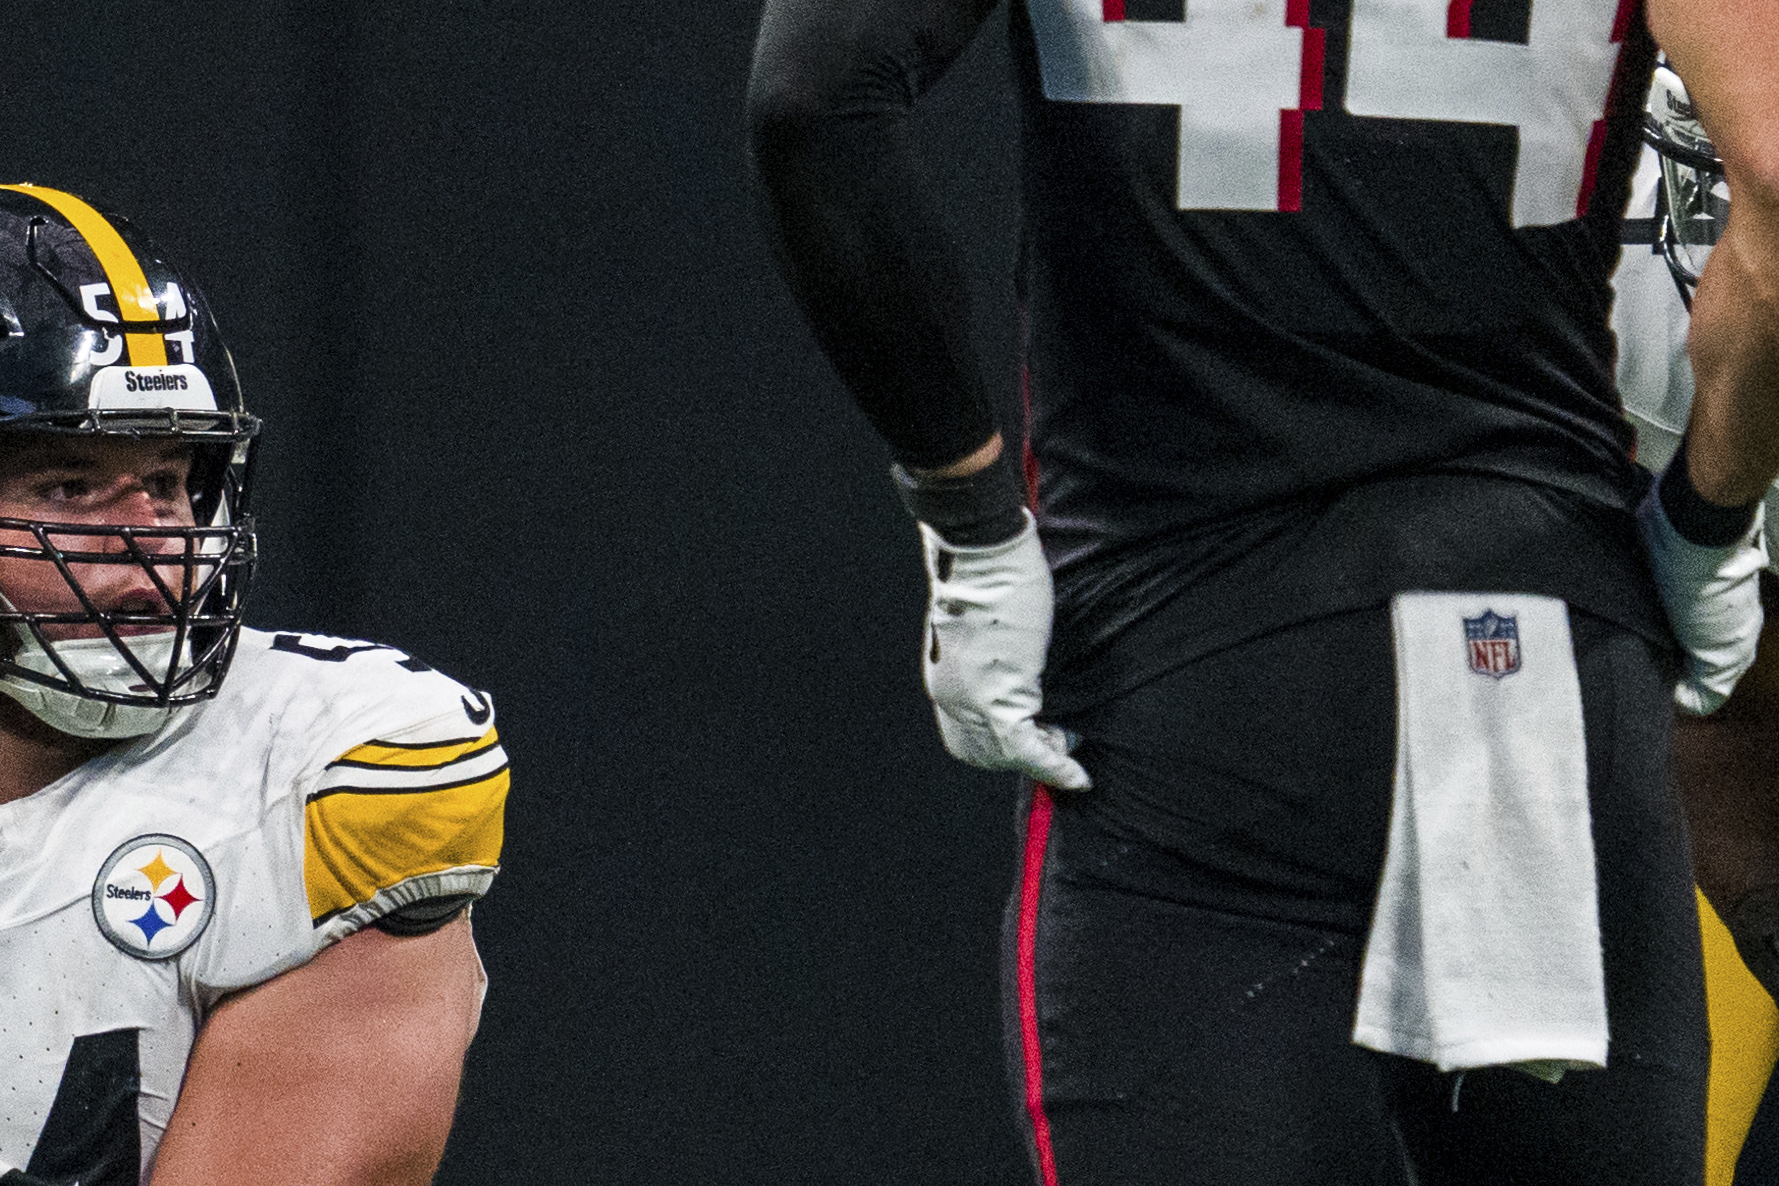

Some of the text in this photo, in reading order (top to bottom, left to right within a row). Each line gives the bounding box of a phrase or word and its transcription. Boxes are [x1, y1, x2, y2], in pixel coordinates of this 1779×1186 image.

[79, 282, 194, 365] 54
[125, 370, 188, 392] Steelers
[1473, 641, 1516, 673] NFL
[106, 884, 151, 901] Steelers
